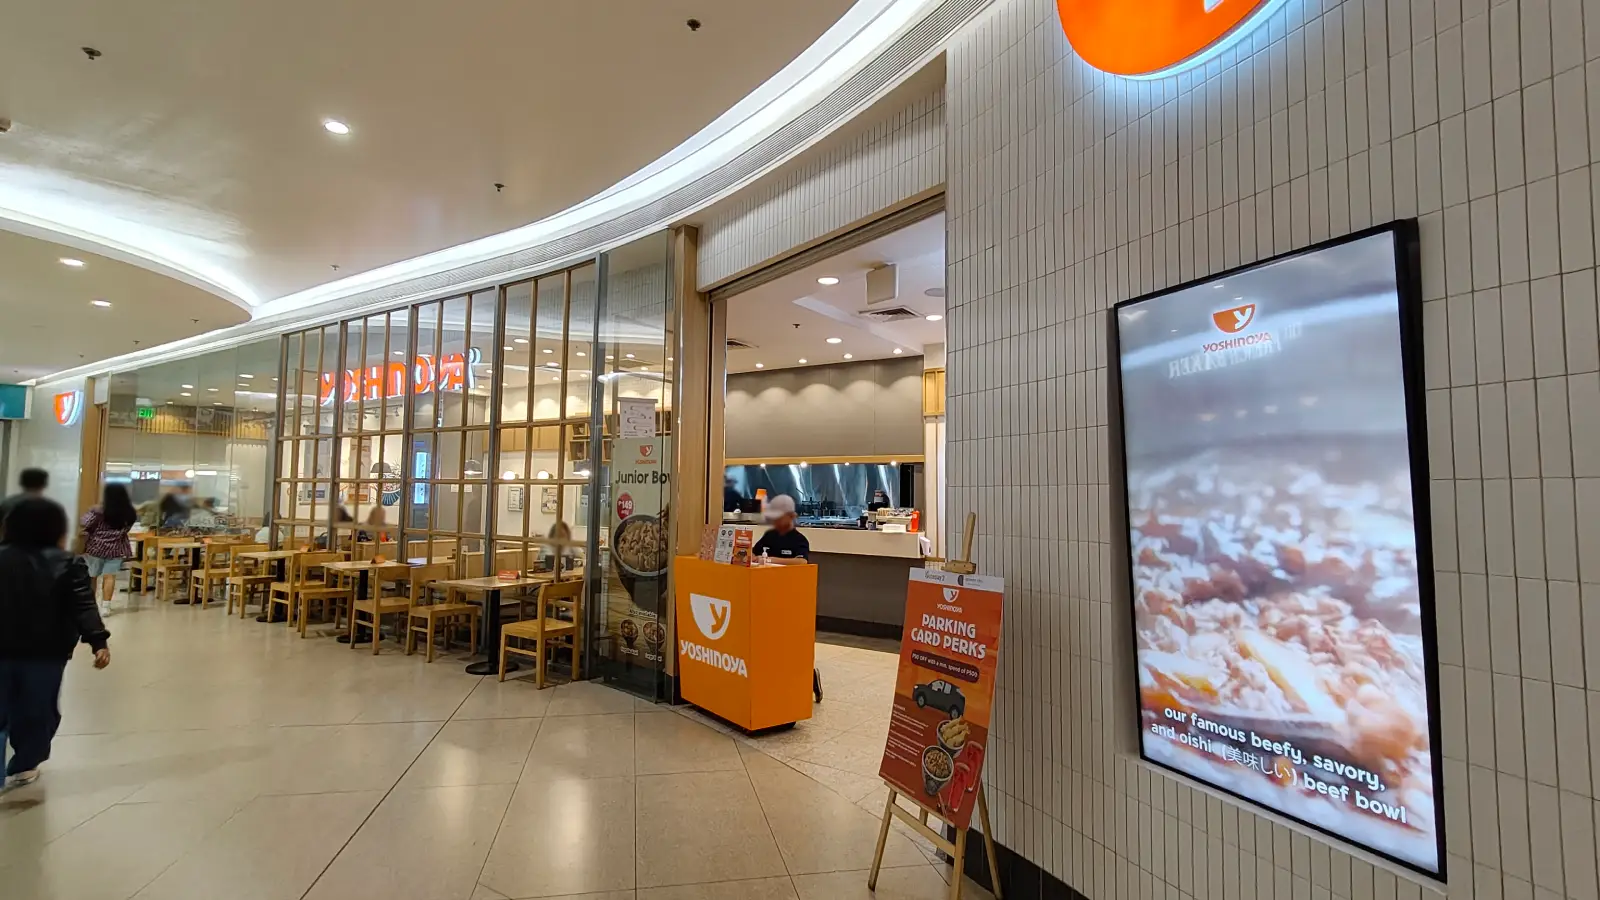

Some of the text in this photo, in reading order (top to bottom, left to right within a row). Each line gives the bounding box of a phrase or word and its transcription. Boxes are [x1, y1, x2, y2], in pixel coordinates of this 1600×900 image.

[1202, 332, 1272, 353] YOSHINOYA
[319, 353, 470, 406] YOSHNOYA
[615, 470, 649, 484] Junior
[936, 603, 963, 613] YOSHINOYA
[921, 613, 976, 639] PARKING
[910, 627, 987, 660] CARD PERKS
[680, 639, 748, 678] YOSHINOYA
[948, 664, 961, 673] spend
[1164, 707, 1386, 792] our famous beefy, savory,
[1151, 722, 1175, 741] and
[1179, 729, 1213, 753] oishi
[1303, 773, 1350, 802] beef
[1355, 790, 1408, 824] bowl
